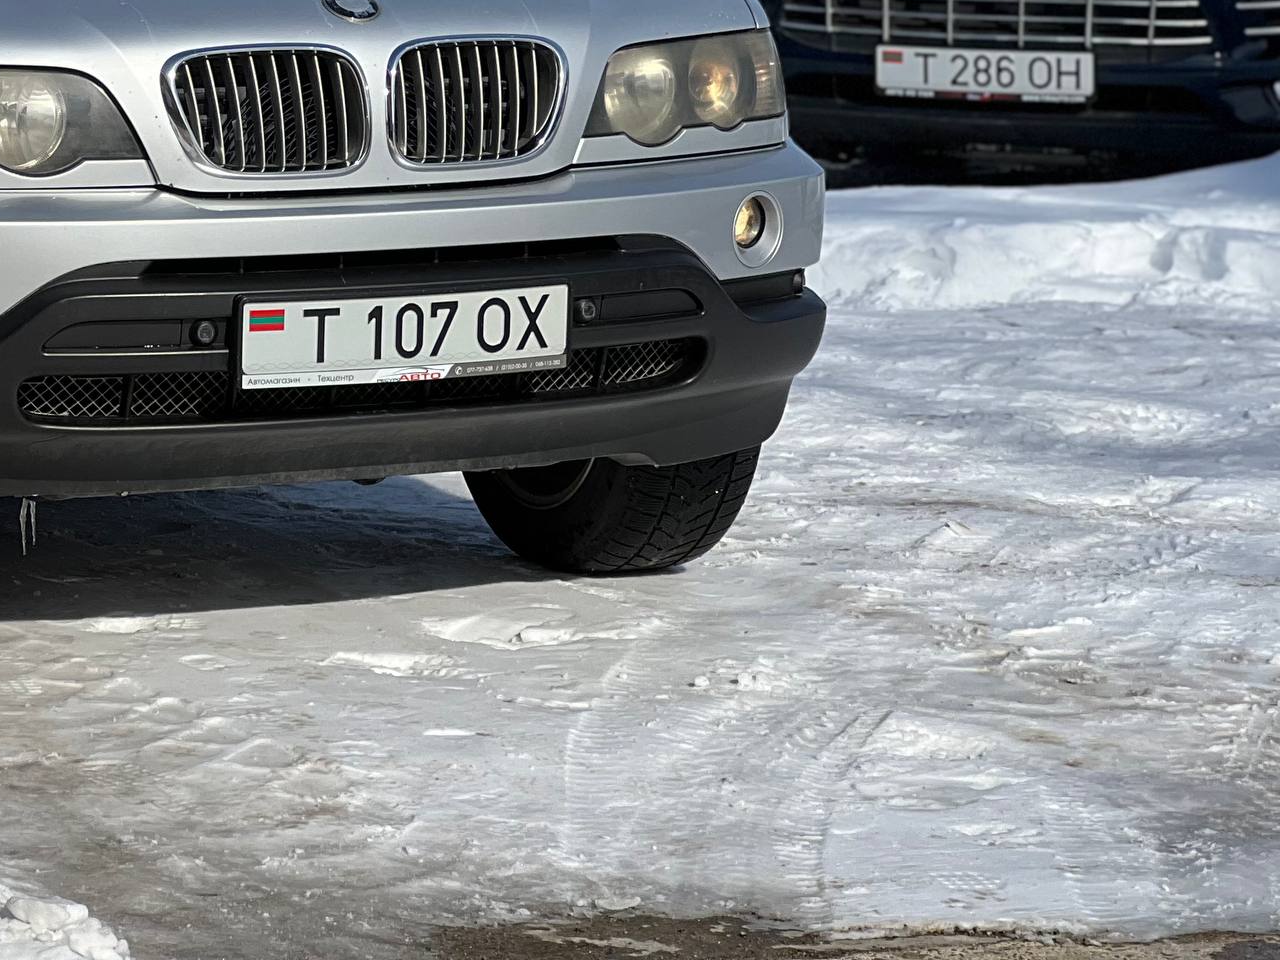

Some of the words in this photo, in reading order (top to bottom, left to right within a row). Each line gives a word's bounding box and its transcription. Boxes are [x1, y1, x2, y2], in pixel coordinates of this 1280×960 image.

[914, 52, 937, 85] T
[950, 54, 1015, 88] 286
[1028, 56, 1080, 89] OH
[303, 307, 341, 363] T
[368, 300, 459, 360] 107
[476, 294, 550, 353] OX
